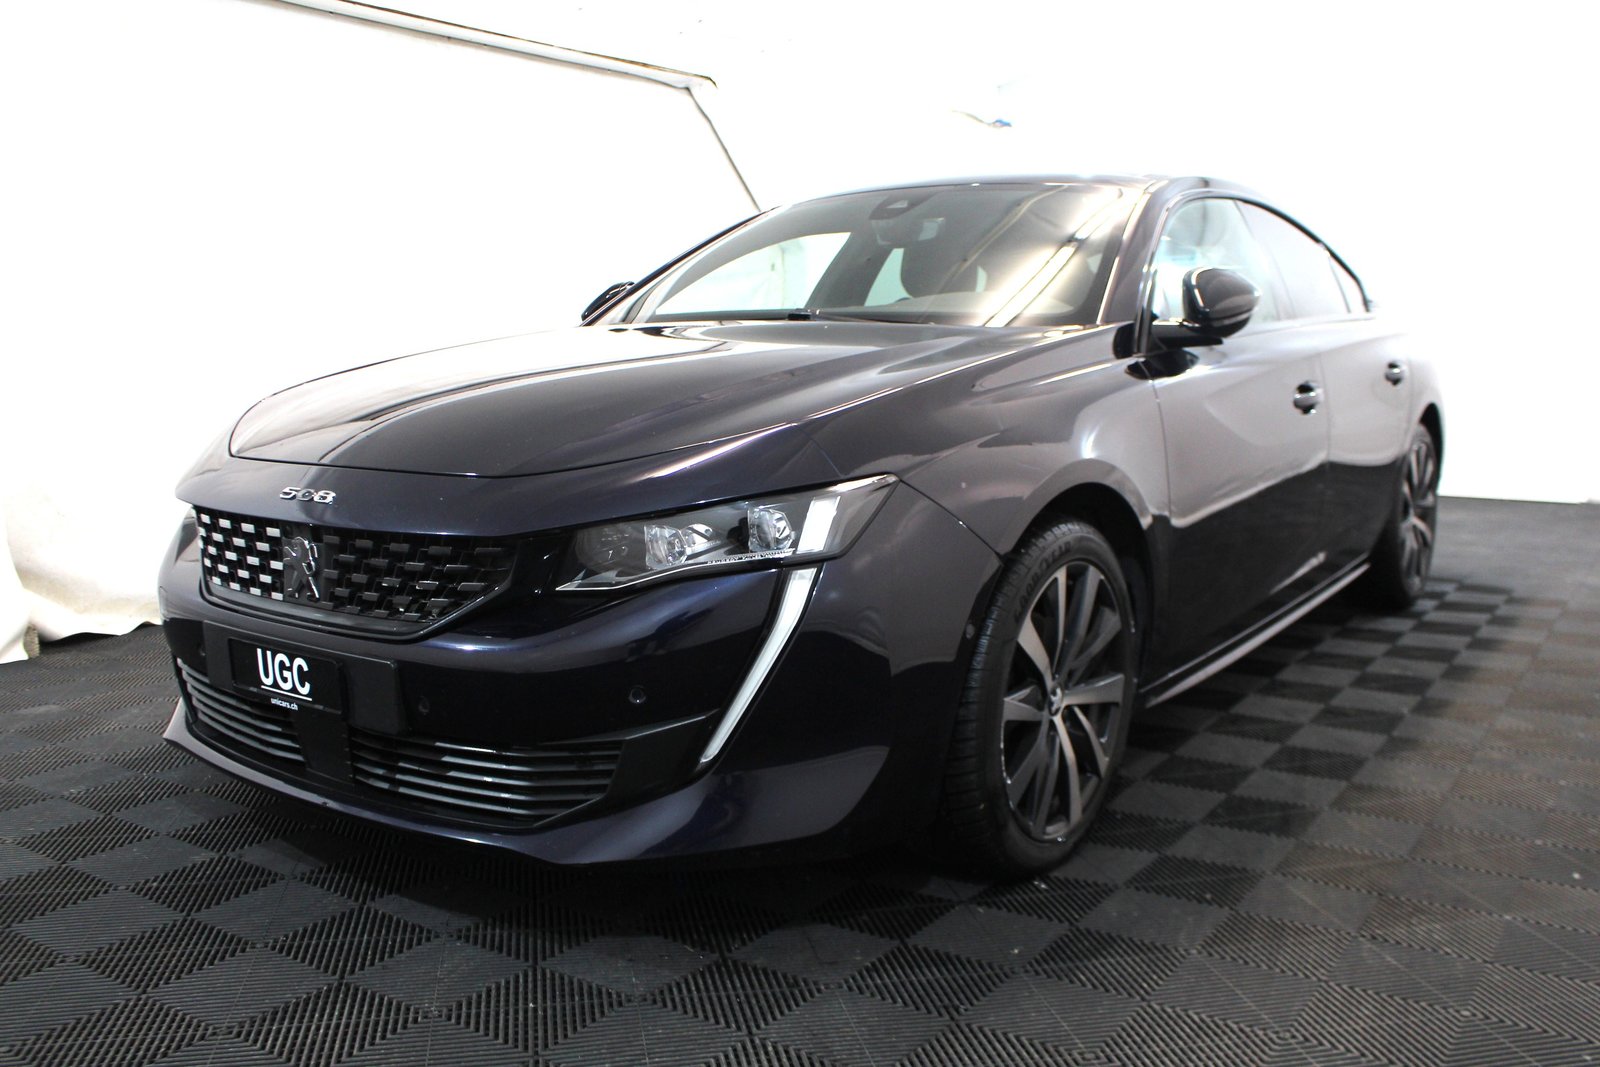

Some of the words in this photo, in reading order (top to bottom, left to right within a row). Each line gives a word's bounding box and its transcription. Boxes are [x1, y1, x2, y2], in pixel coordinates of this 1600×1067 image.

[279, 486, 336, 505] 508
[256, 648, 311, 695] UGC
[270, 697, 299, 711] unicars.ch
